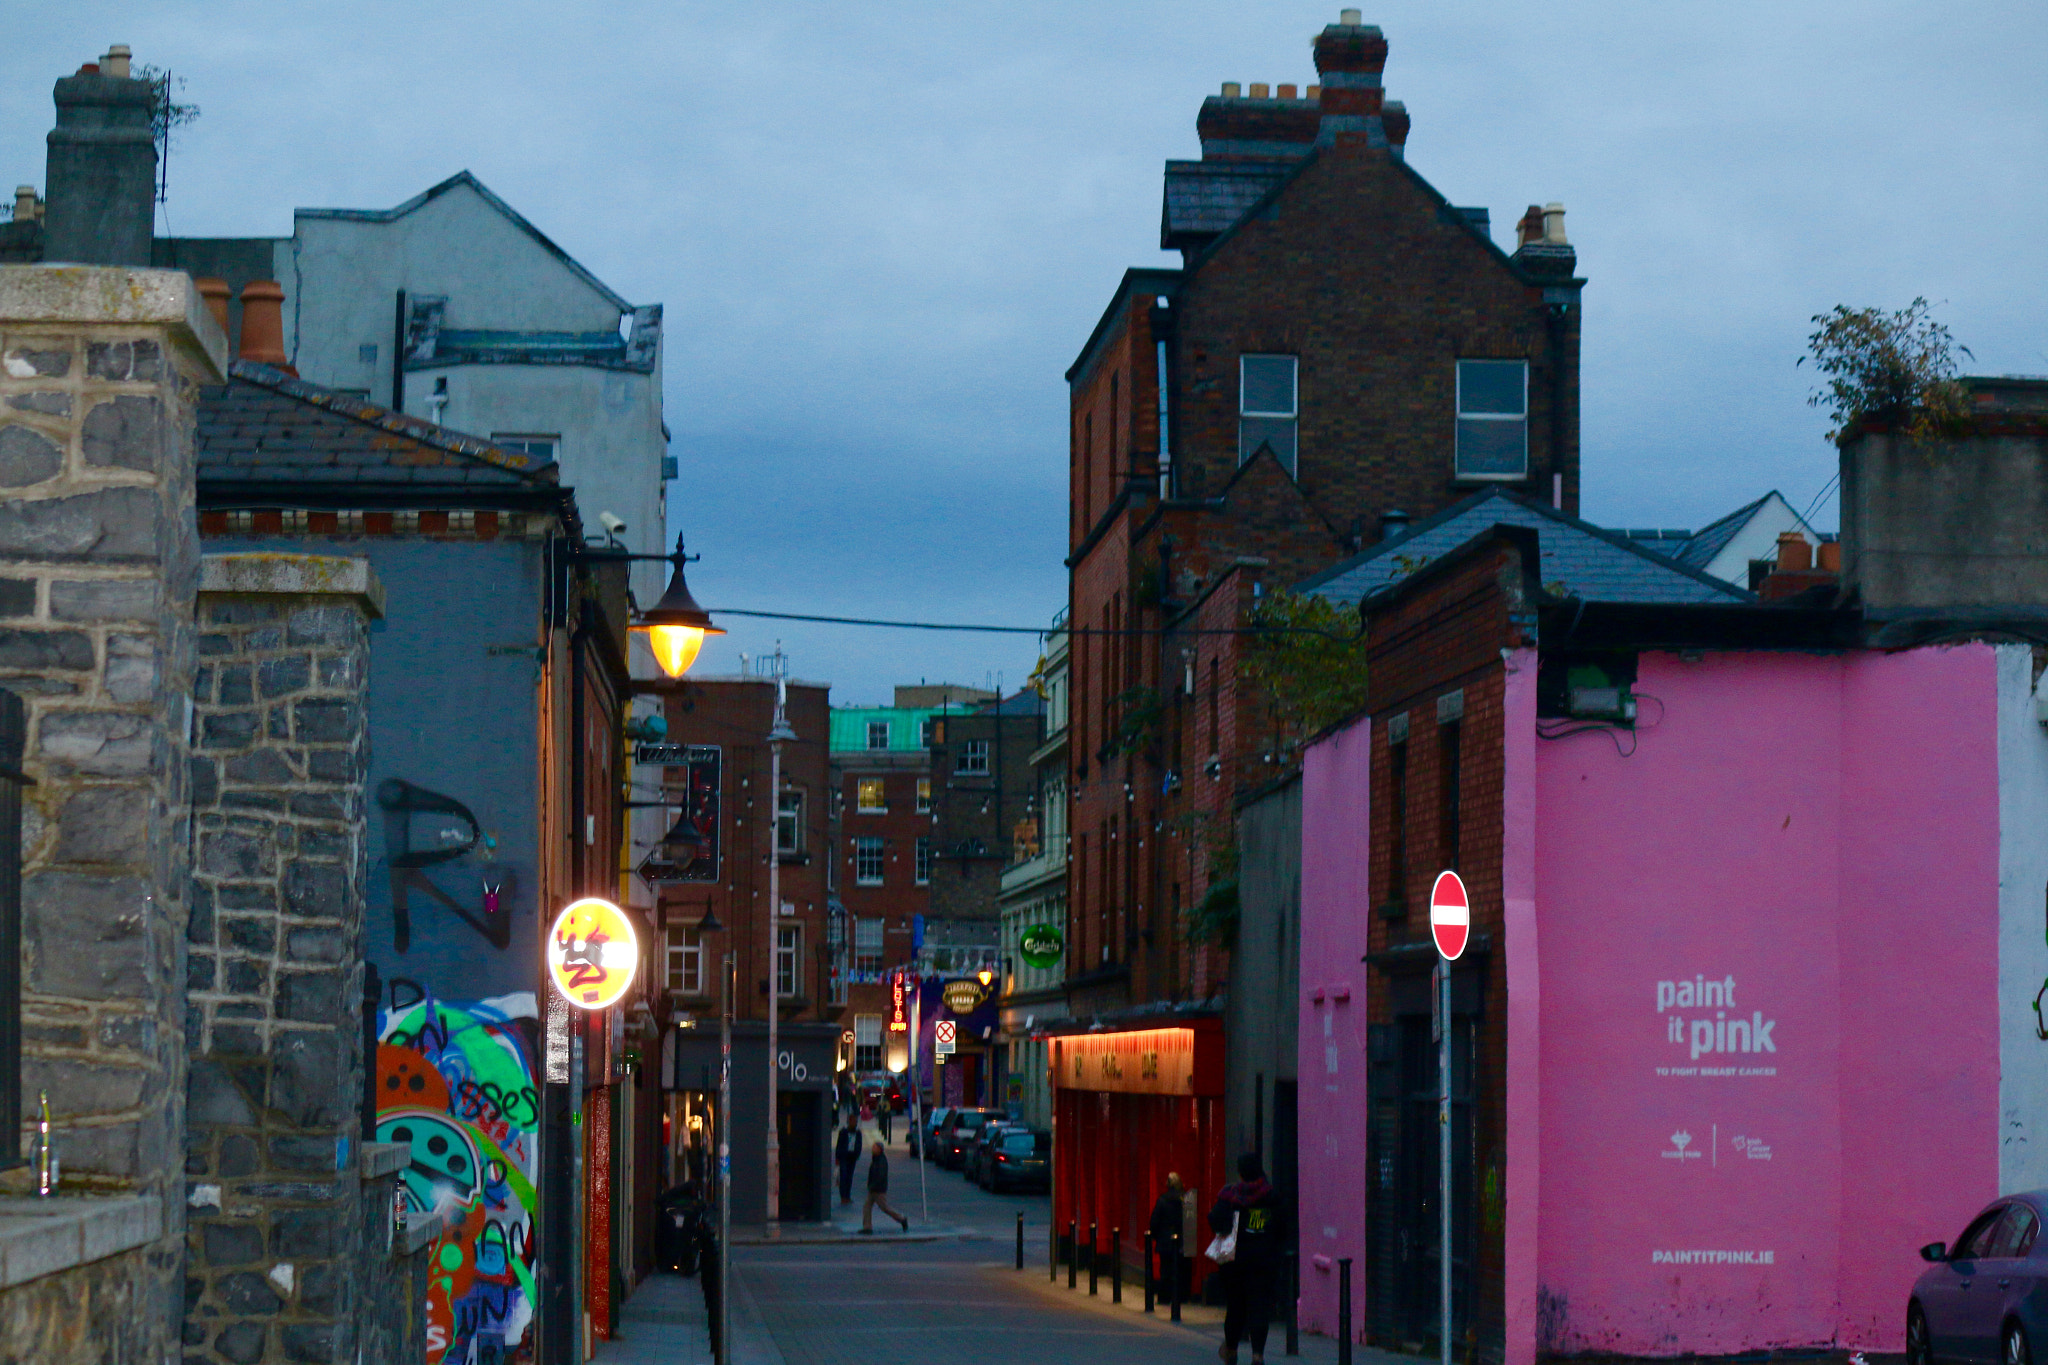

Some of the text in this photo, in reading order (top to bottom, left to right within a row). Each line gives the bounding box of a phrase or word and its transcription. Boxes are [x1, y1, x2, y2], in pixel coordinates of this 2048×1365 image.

[1657, 973, 1736, 1013] paint
[1668, 1010, 1777, 1061] it pink
[1656, 1066, 1777, 1077] TO FIGHT BREAST CANCER
[1652, 1250, 1775, 1265] PAINTITPINK.IE
